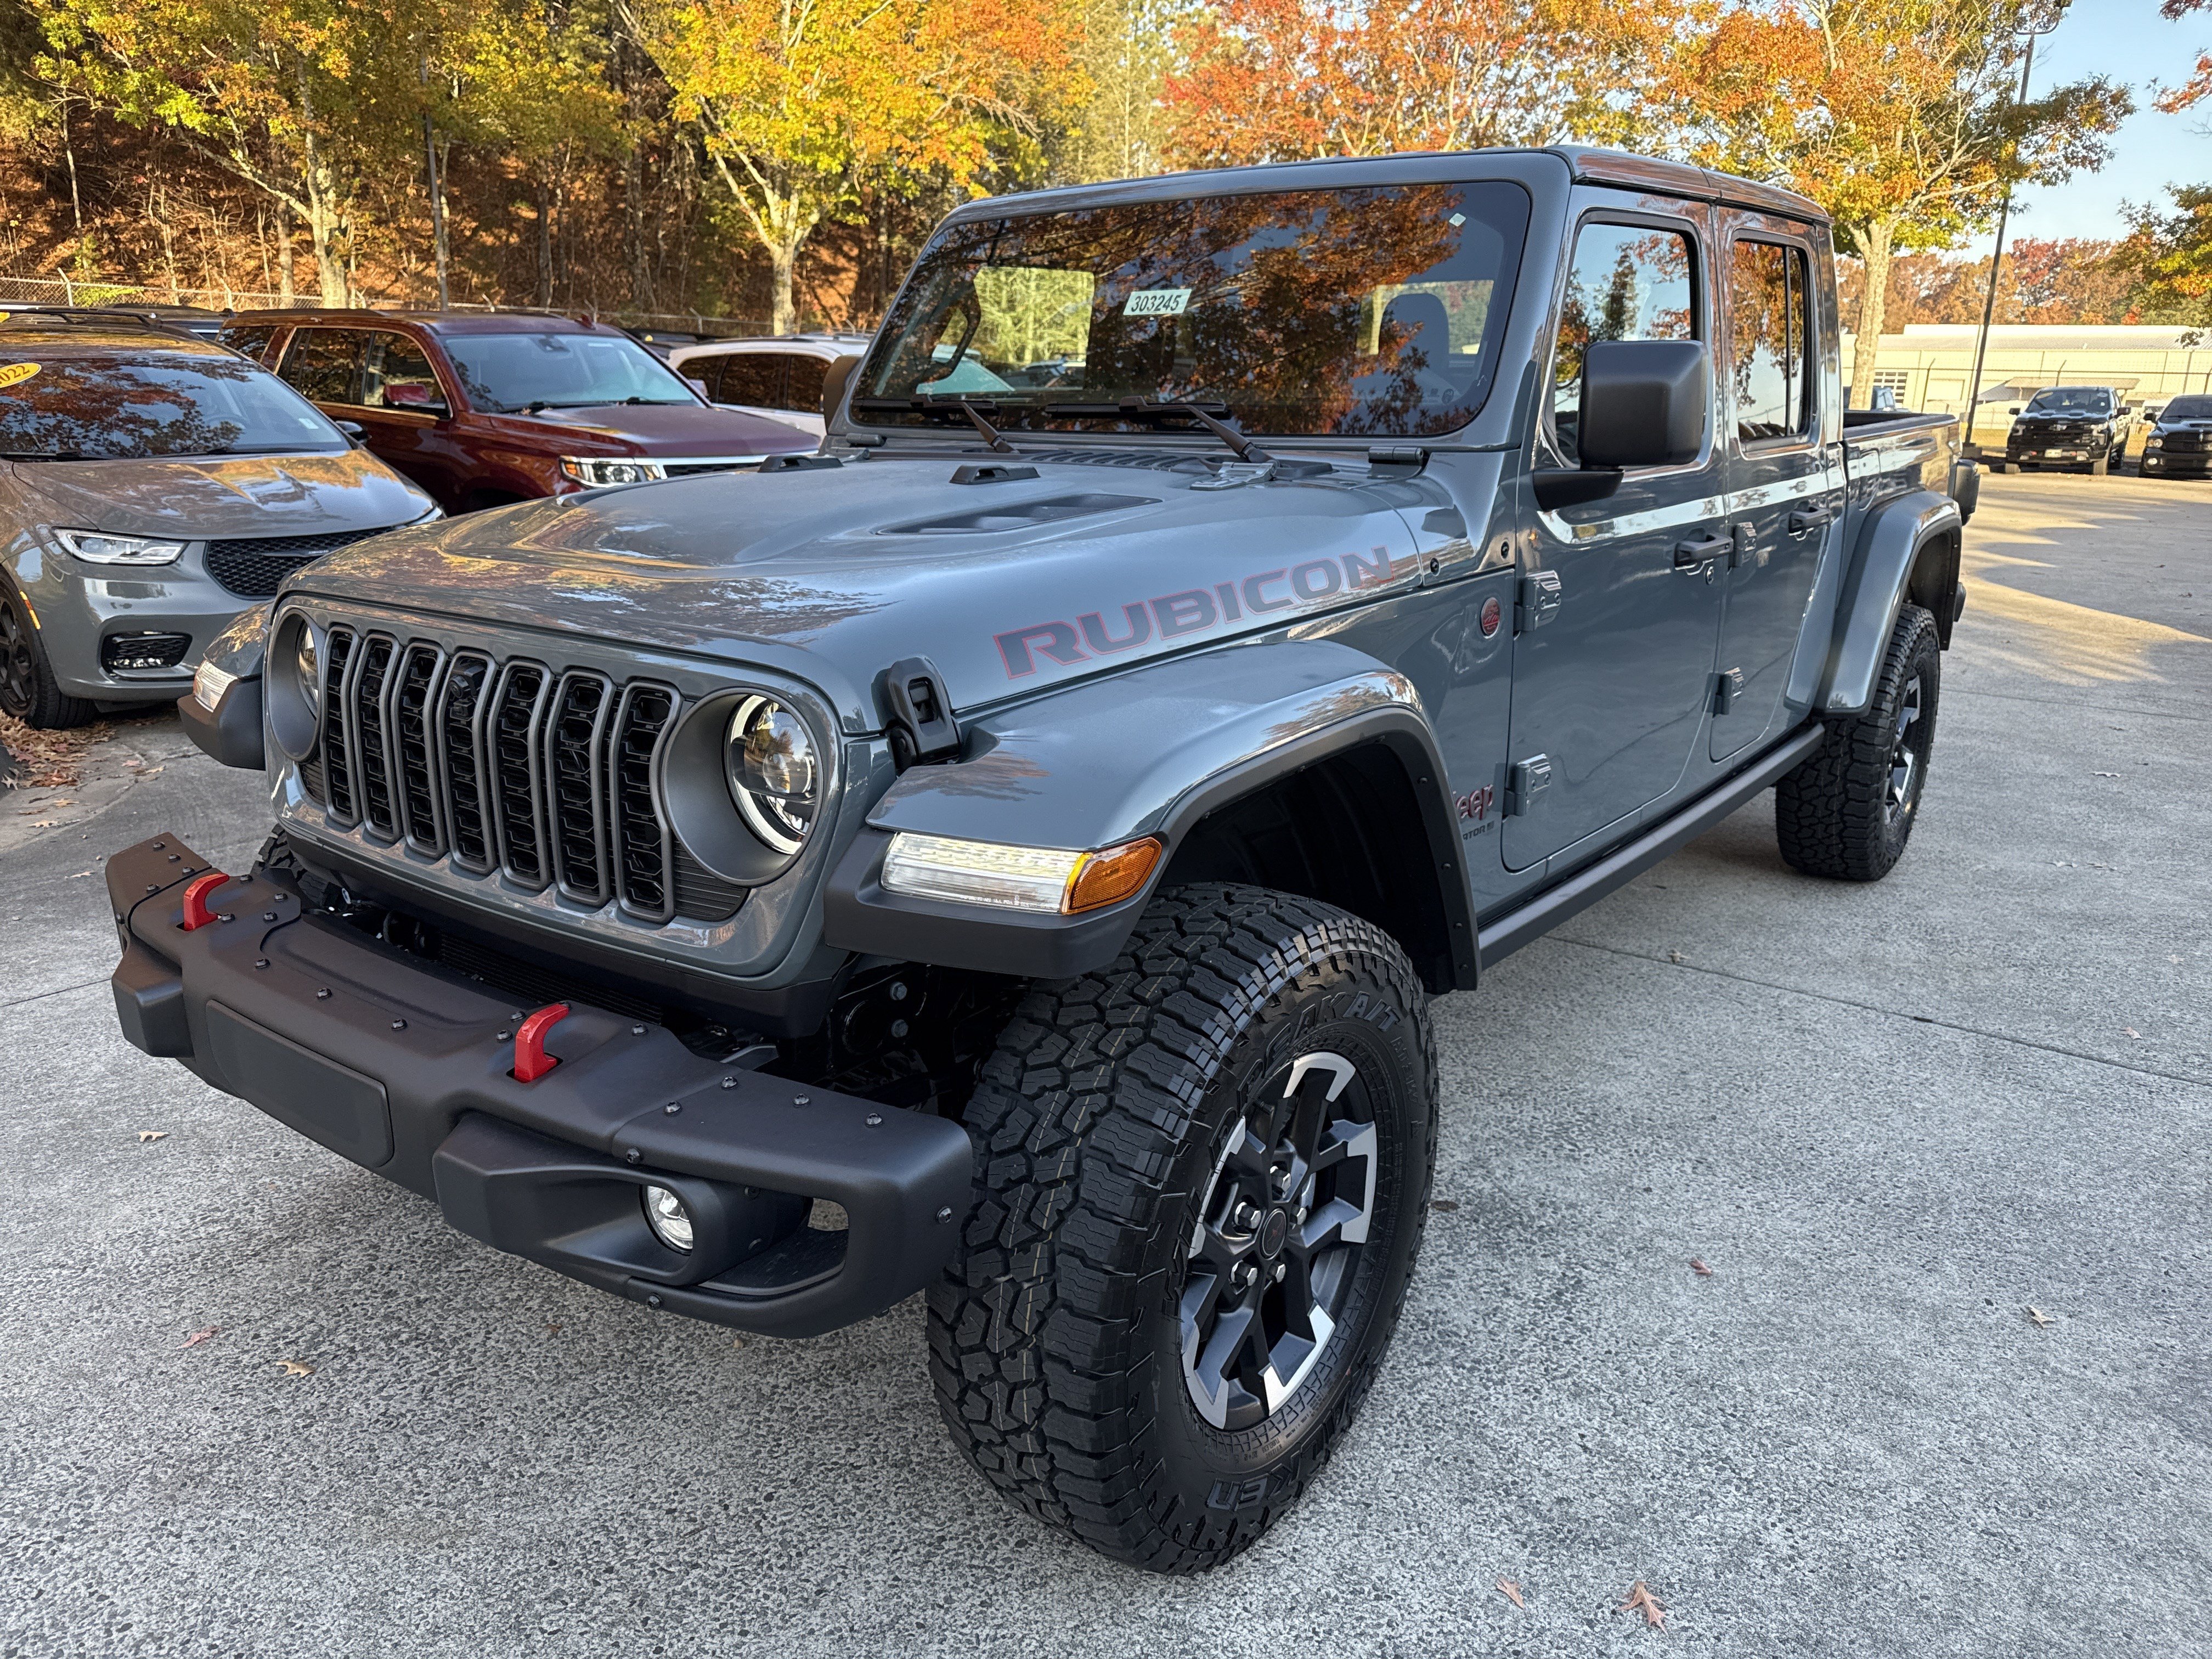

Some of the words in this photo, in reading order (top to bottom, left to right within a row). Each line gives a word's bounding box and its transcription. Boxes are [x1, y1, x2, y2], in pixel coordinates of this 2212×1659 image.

[1131, 295, 1182, 312] 303245
[0, 365, 30, 384] 022
[993, 546, 1395, 680] RUBICON
[1454, 784, 1493, 821] eep
